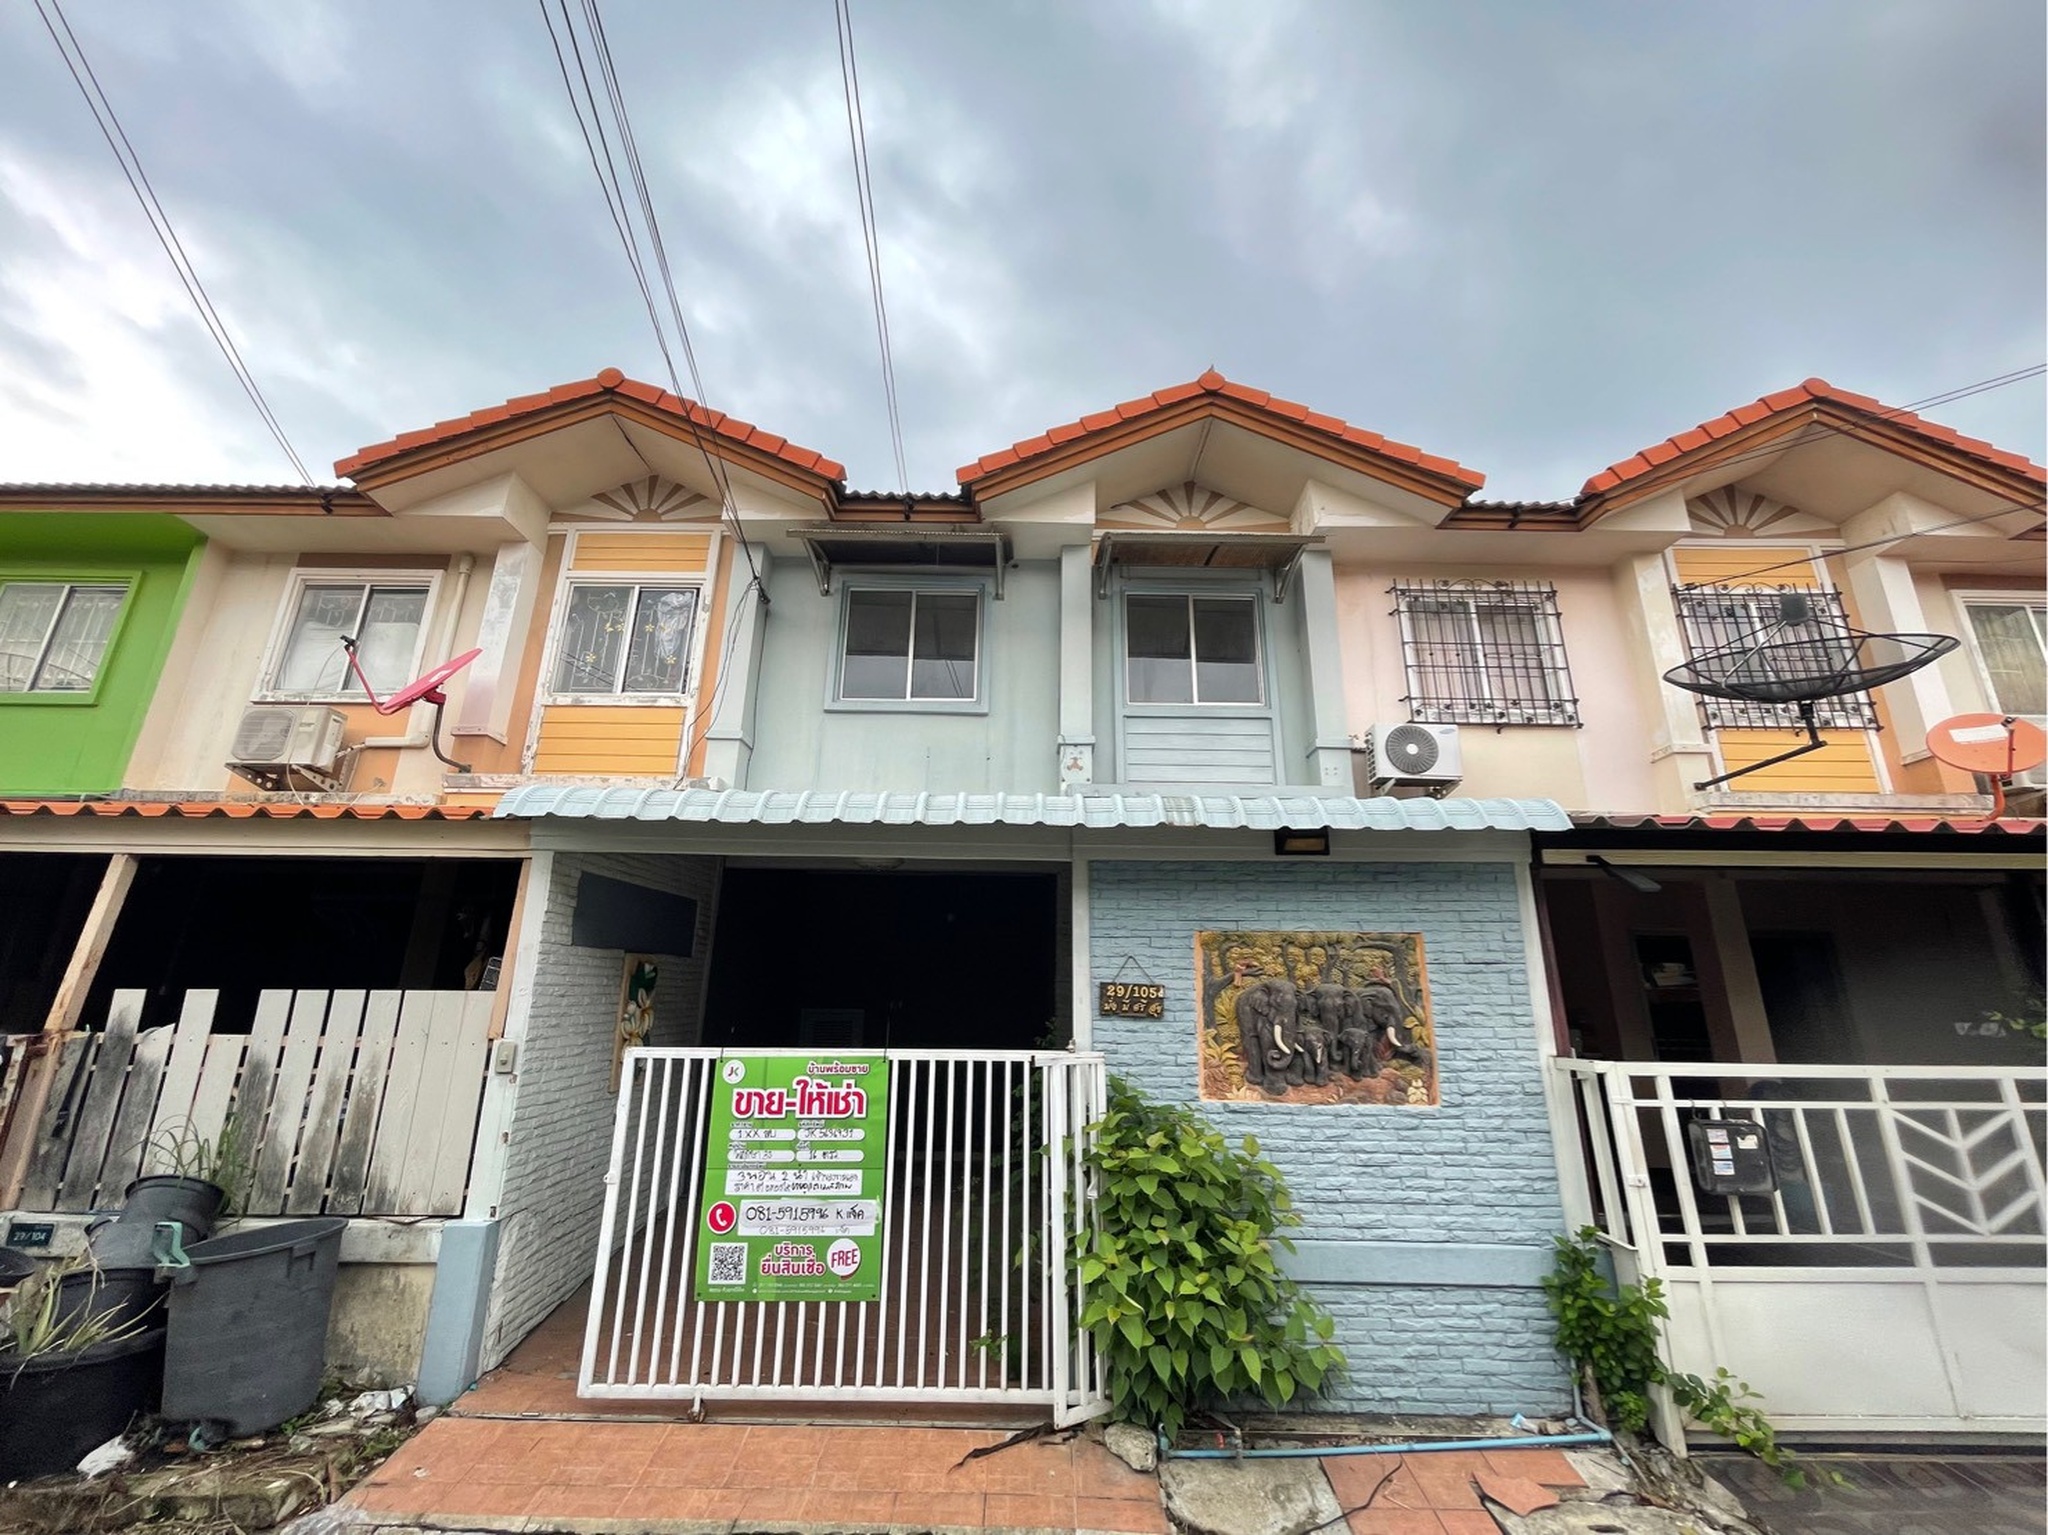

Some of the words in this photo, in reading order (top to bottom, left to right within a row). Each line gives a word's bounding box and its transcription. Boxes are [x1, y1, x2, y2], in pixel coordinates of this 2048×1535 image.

[734, 1079, 864, 1116] ขาย-ให้เช่า
[775, 1242, 813, 1256] บริการ
[831, 1248, 858, 1269] FREE
[761, 1254, 825, 1274] ยื่นสินเชื่อ
